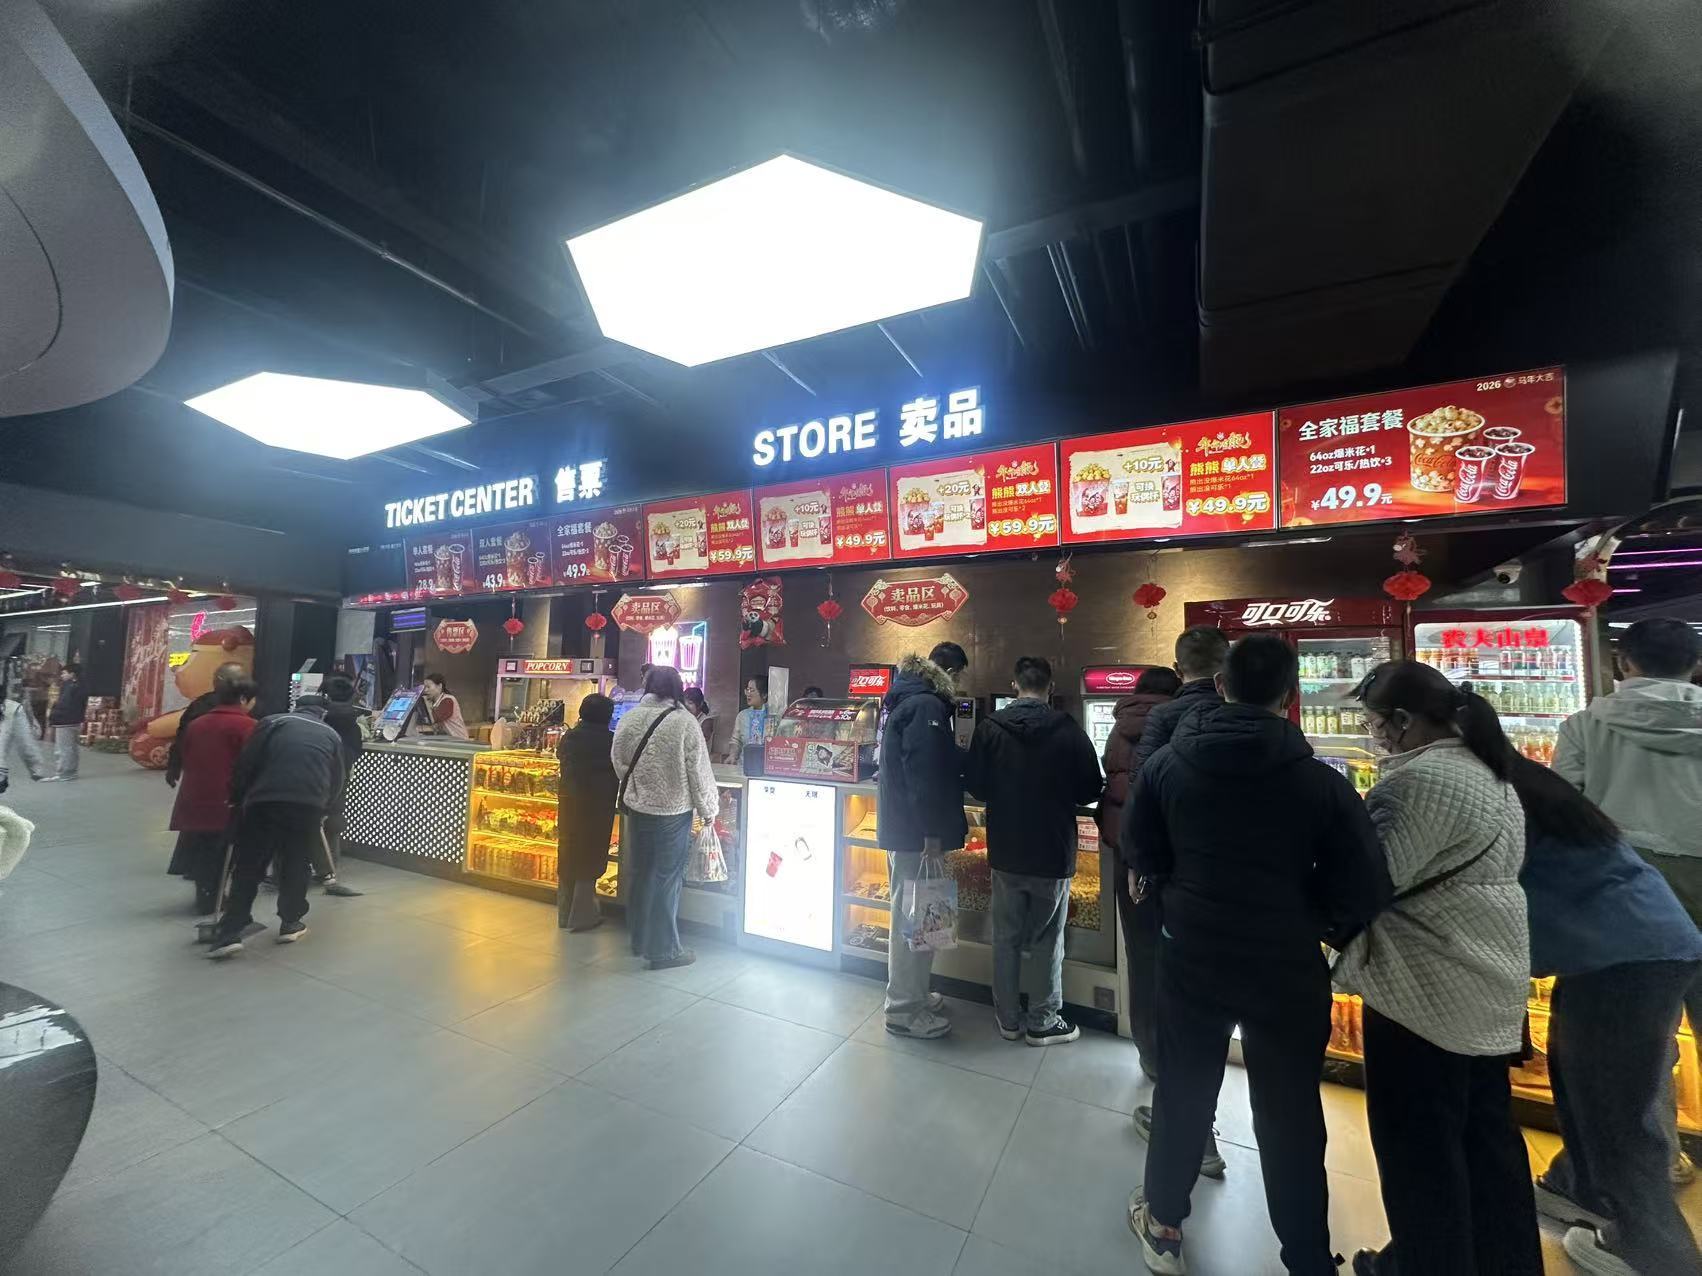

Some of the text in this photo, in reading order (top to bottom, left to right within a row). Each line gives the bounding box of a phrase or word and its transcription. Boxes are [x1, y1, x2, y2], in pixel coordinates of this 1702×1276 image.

[1476, 372, 1554, 392] 2026 马年大吉
[753, 388, 982, 466] STORE 卖品
[1299, 409, 1403, 441] 全家福套餐
[1124, 456, 1163, 473] +10元
[384, 461, 604, 528] TICKET CENTER 售票
[937, 480, 970, 496] +20元
[1311, 483, 1393, 511] ¥49.9元
[794, 501, 819, 515] +10元
[1188, 492, 1268, 515] ¥49.9元
[989, 514, 1056, 536] ¥59.9元
[836, 531, 886, 548] ¥49.9元
[710, 546, 753, 563] ¥59.9元
[891, 586, 936, 603] 卖品区
[632, 602, 661, 615] 卖品区
[1241, 598, 1335, 627] 可口可乐
[1440, 627, 1550, 648] 农夫山泉
[527, 661, 568, 672] POPCORN
[852, 675, 887, 687] 可口可乐
